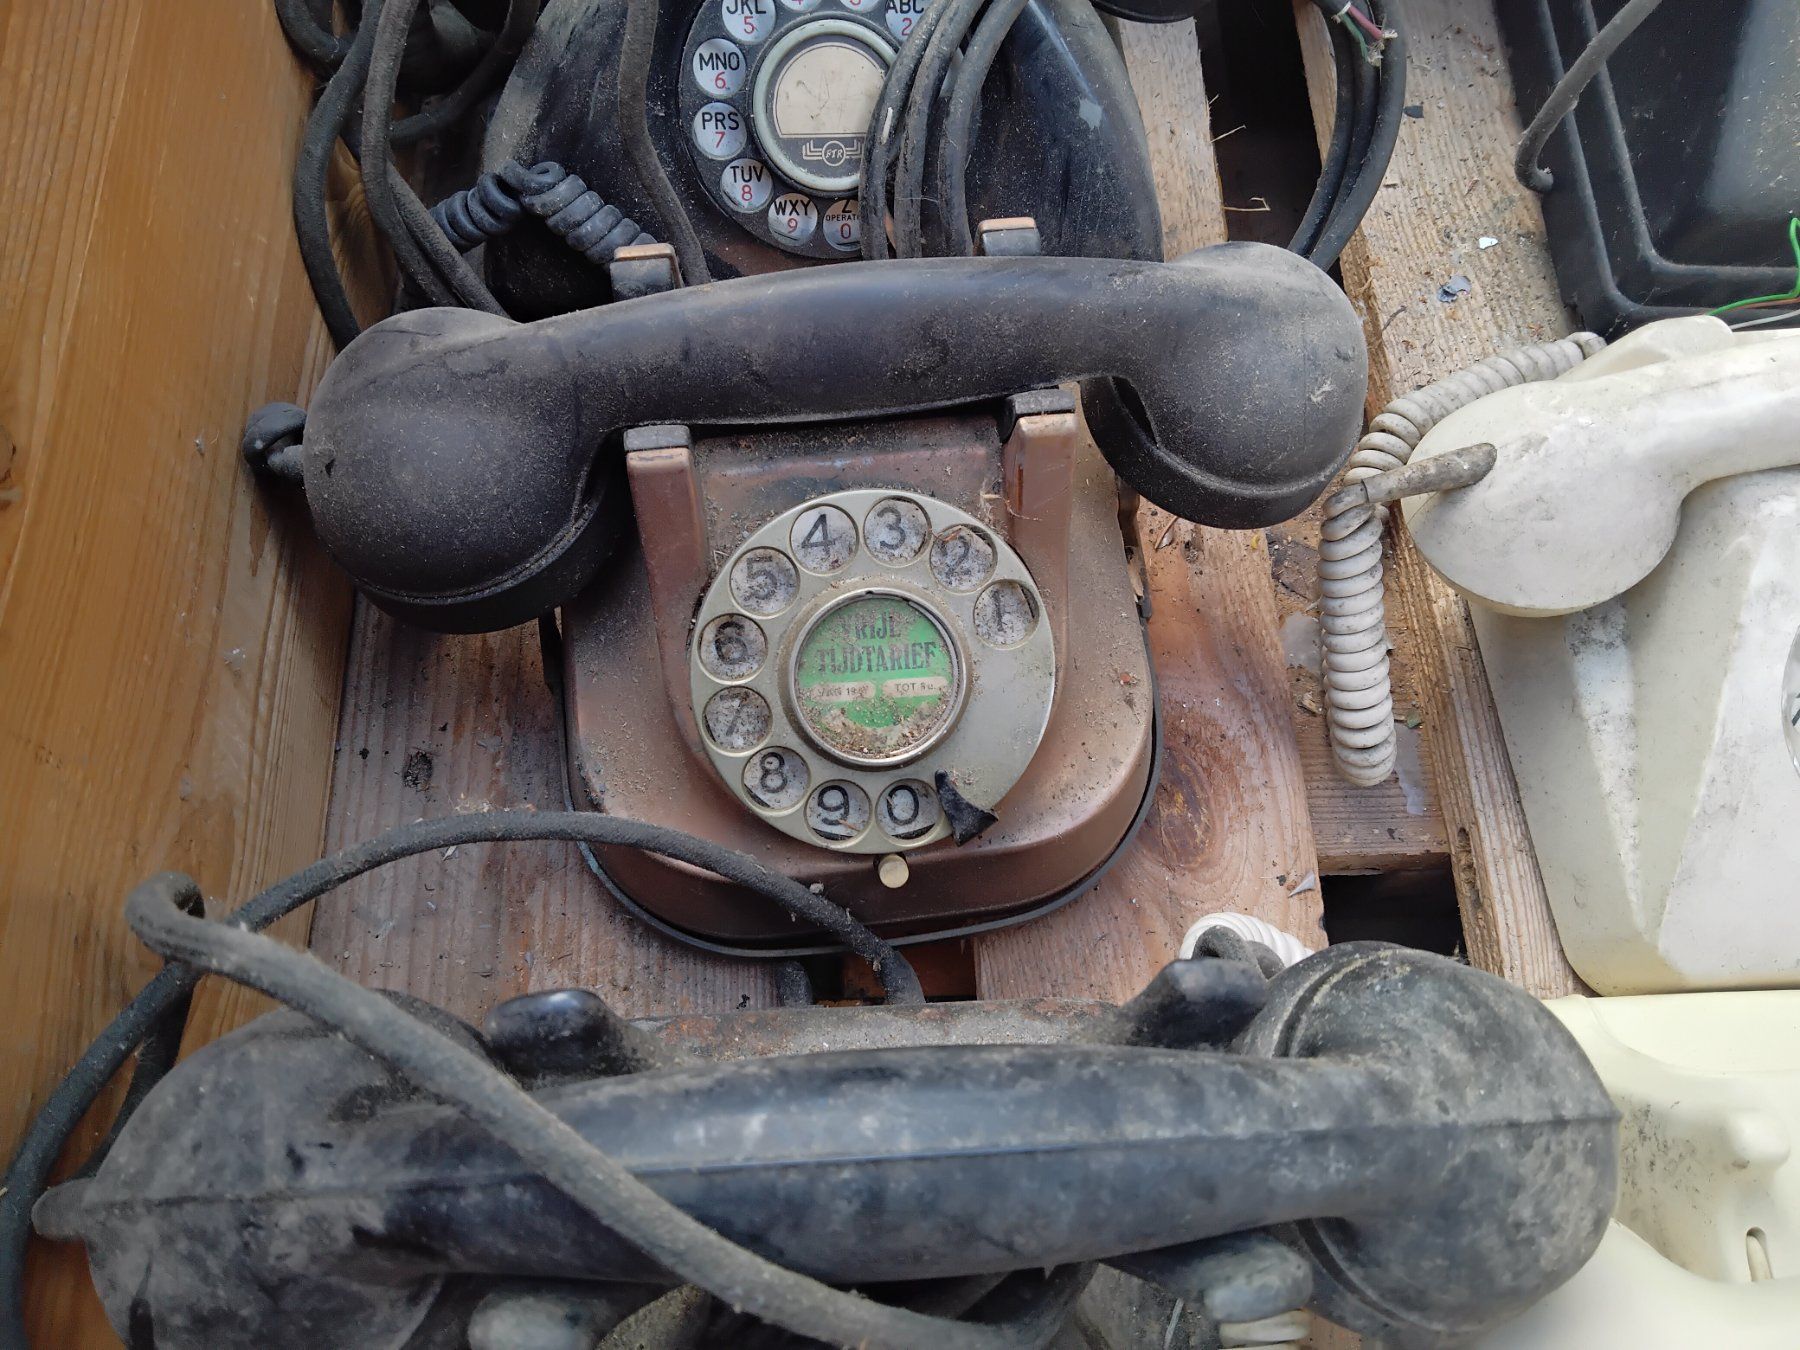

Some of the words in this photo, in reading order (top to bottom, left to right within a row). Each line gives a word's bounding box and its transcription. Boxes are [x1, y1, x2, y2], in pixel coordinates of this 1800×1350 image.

[726, 0, 767, 15] JKL
[887, 0, 925, 14] ABC
[743, 16, 756, 34] 5
[901, 17, 913, 36] 2
[699, 52, 740, 71] MNO
[714, 72, 727, 89] 6
[702, 112, 739, 130] PRS
[715, 131, 726, 149] 7
[730, 166, 764, 184] TUV
[741, 184, 753, 202] 8
[774, 199, 812, 216] WXY
[787, 217, 799, 234] 9
[840, 223, 852, 240] 0
[800, 512, 836, 556] 4
[876, 506, 907, 551] 3
[944, 534, 973, 576] 2
[746, 556, 779, 601] 5
[713, 620, 749, 666] 6
[718, 692, 751, 736] 7
[759, 752, 789, 794] 8
[817, 785, 850, 826] 9
[886, 784, 920, 826] 0
